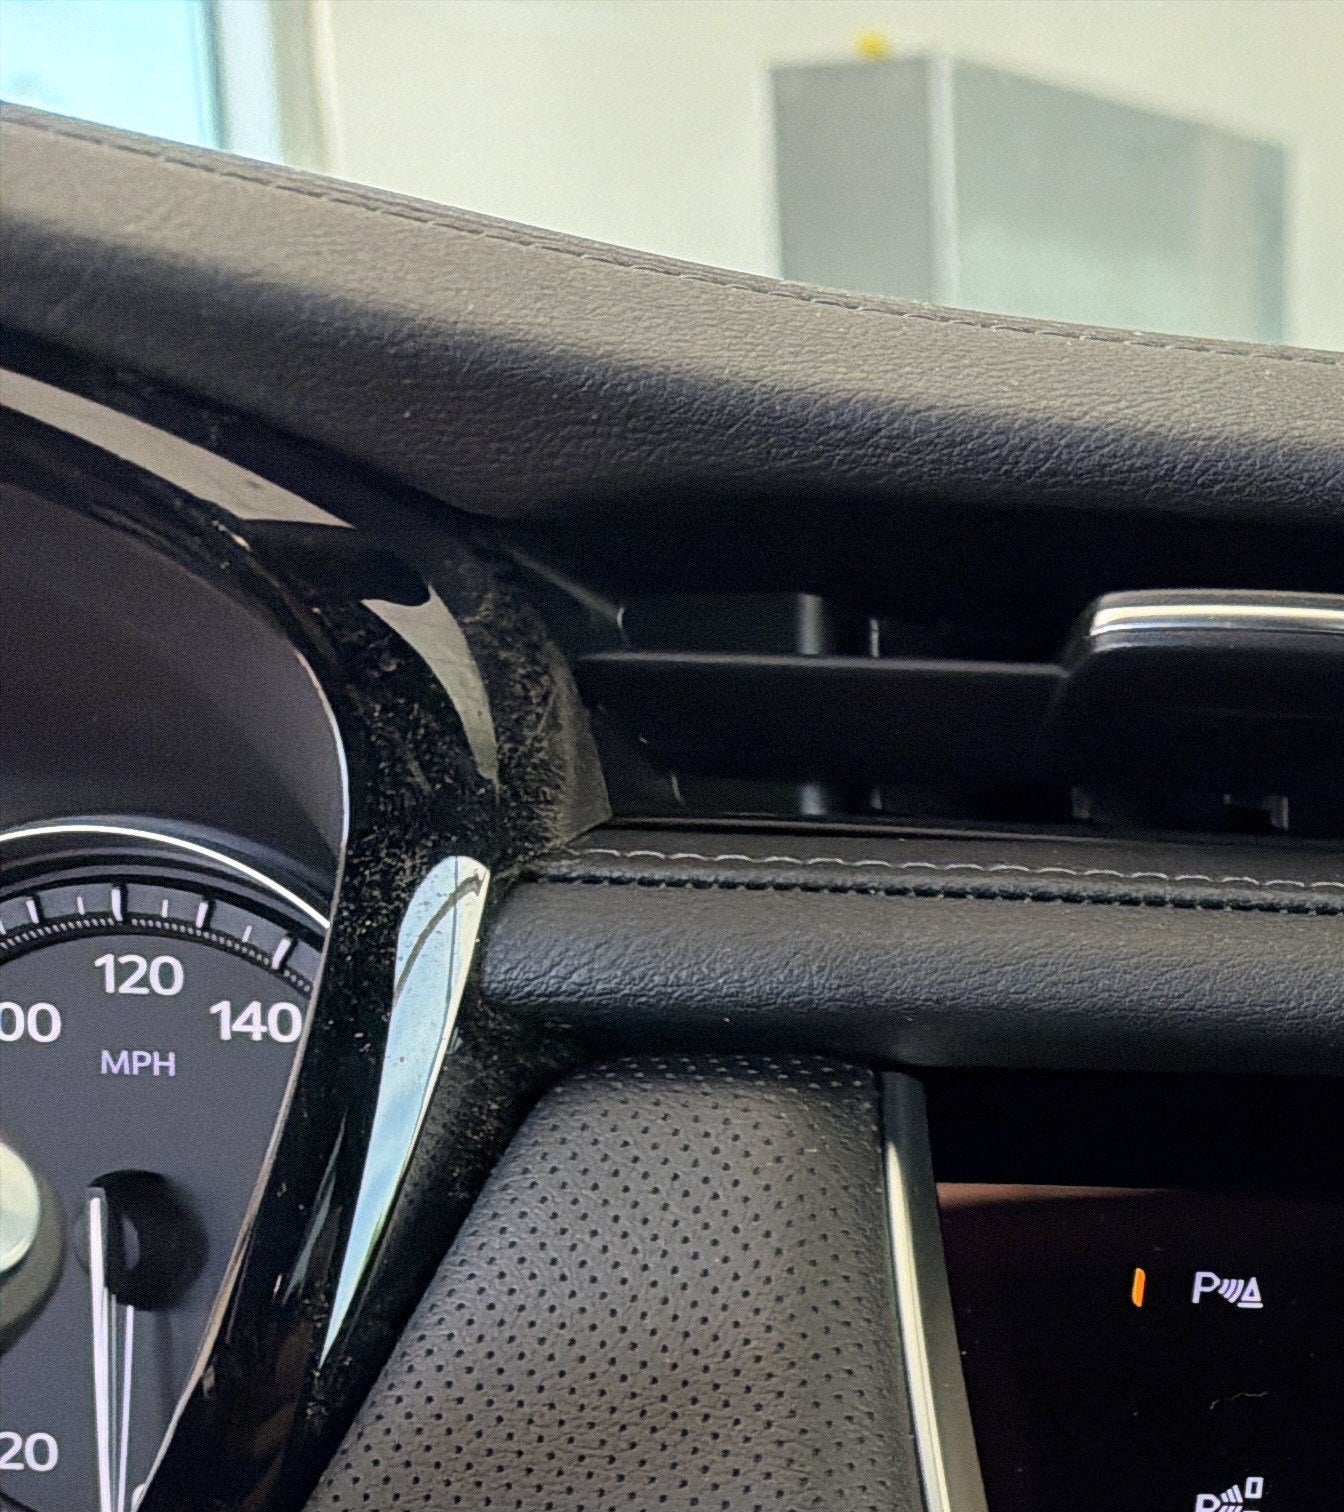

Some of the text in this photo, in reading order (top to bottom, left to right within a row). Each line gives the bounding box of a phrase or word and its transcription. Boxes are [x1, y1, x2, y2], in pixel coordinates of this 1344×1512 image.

[95, 953, 185, 996] 120
[209, 1000, 302, 1043] 140
[100, 1050, 176, 1077] MPH
